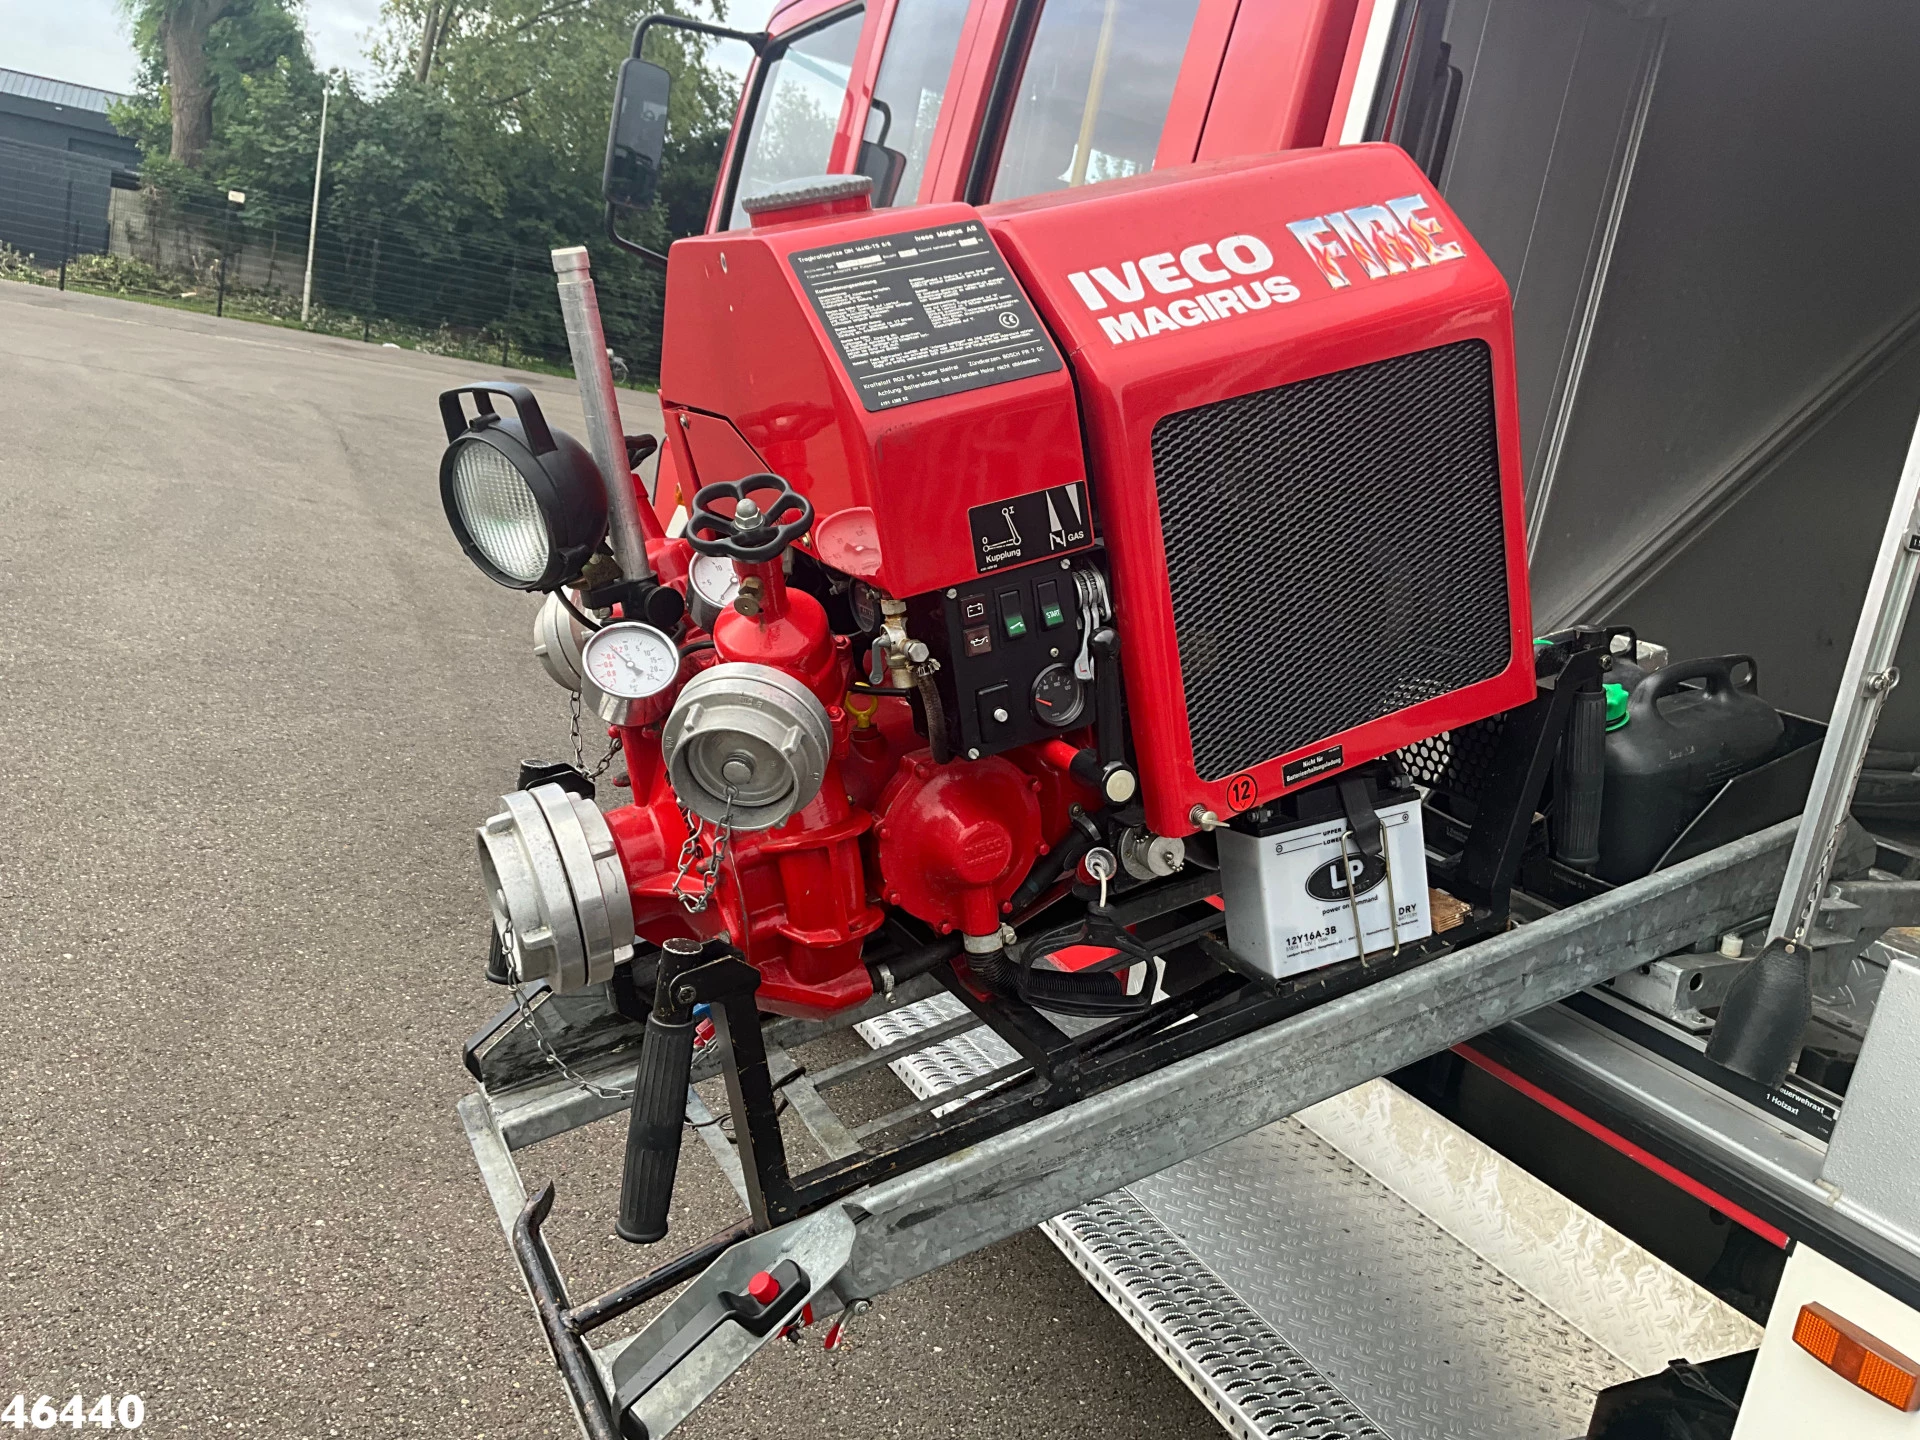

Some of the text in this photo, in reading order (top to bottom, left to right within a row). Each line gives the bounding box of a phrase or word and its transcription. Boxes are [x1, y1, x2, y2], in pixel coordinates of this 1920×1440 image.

[936, 228, 963, 238] Magirus
[966, 225, 977, 233] AG
[1286, 193, 1466, 290] FIRE
[1067, 234, 1274, 311] IVECO
[1097, 275, 1301, 345] MAGIRUS
[1002, 351, 1020, 360] BOSCH
[921, 369, 938, 378] Super
[1067, 531, 1084, 541] GAS
[985, 548, 1021, 563] Kupplung
[1045, 609, 1060, 618] START
[1302, 755, 1324, 768] Nicht für
[1233, 780, 1251, 802] 12
[1322, 827, 1342, 836] UPPER
[1329, 859, 1364, 890] LP
[1321, 905, 1341, 916] power
[1398, 903, 1417, 916] DRY
[1286, 925, 1337, 946] 12Y16A-3B
[1771, 1095, 1799, 1116] Holzaxt
[1779, 1087, 1825, 1114] euerwehraxt
